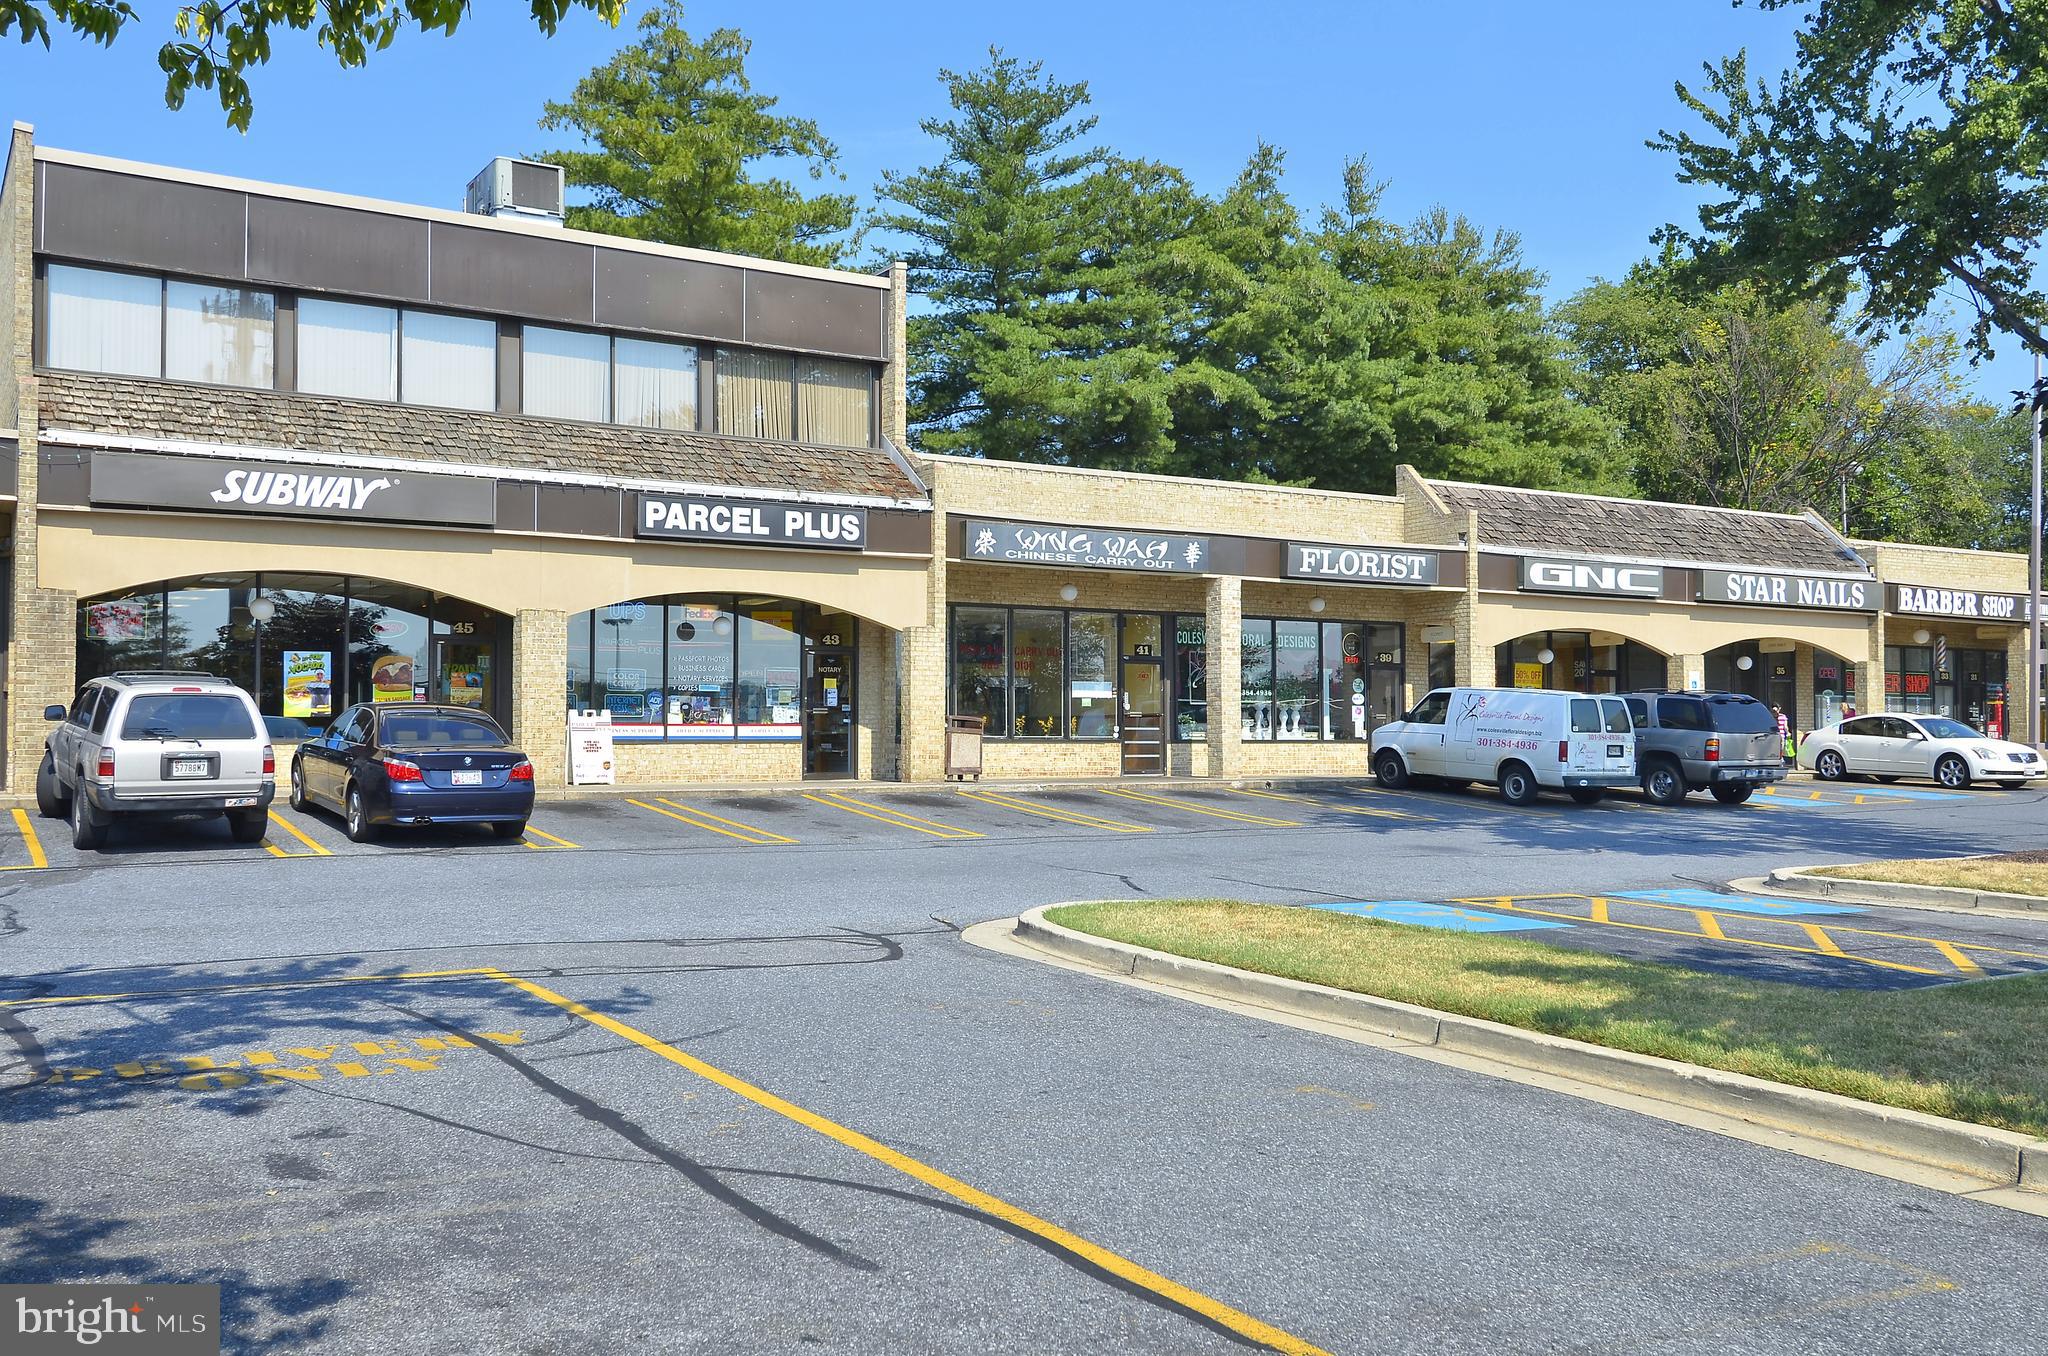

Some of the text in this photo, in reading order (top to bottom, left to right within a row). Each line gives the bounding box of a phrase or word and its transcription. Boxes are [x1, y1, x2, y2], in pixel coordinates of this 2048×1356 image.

[210, 469, 392, 510] SUBWAY
[645, 501, 860, 541] PARCEL PLUS
[1015, 529, 1169, 560] WING WAH
[1005, 549, 1175, 569] CHINESE CARRY OUT
[1300, 548, 1427, 580] FLORIST
[1529, 562, 1659, 592] GNC
[1727, 573, 1865, 608] STAR NAILS
[609, 602, 646, 621] UPS
[1900, 587, 1978, 616] BARBER
[1982, 595, 2015, 617] SHOP
[453, 622, 474, 634] 45
[822, 635, 840, 645] 43
[1278, 635, 1316, 649] DESIGNS
[1136, 645, 1150, 655] 41
[1379, 653, 1392, 662] 39
[613, 672, 640, 680] COLOR
[1531, 671, 1543, 681] OFF
[1776, 666, 1786, 675] 35
[677, 684, 698, 692] COPIES
[1905, 674, 1930, 693] SHOP
[1477, 738, 1538, 751] 301-384-4936
[179, 1055, 445, 1091] ONLY
